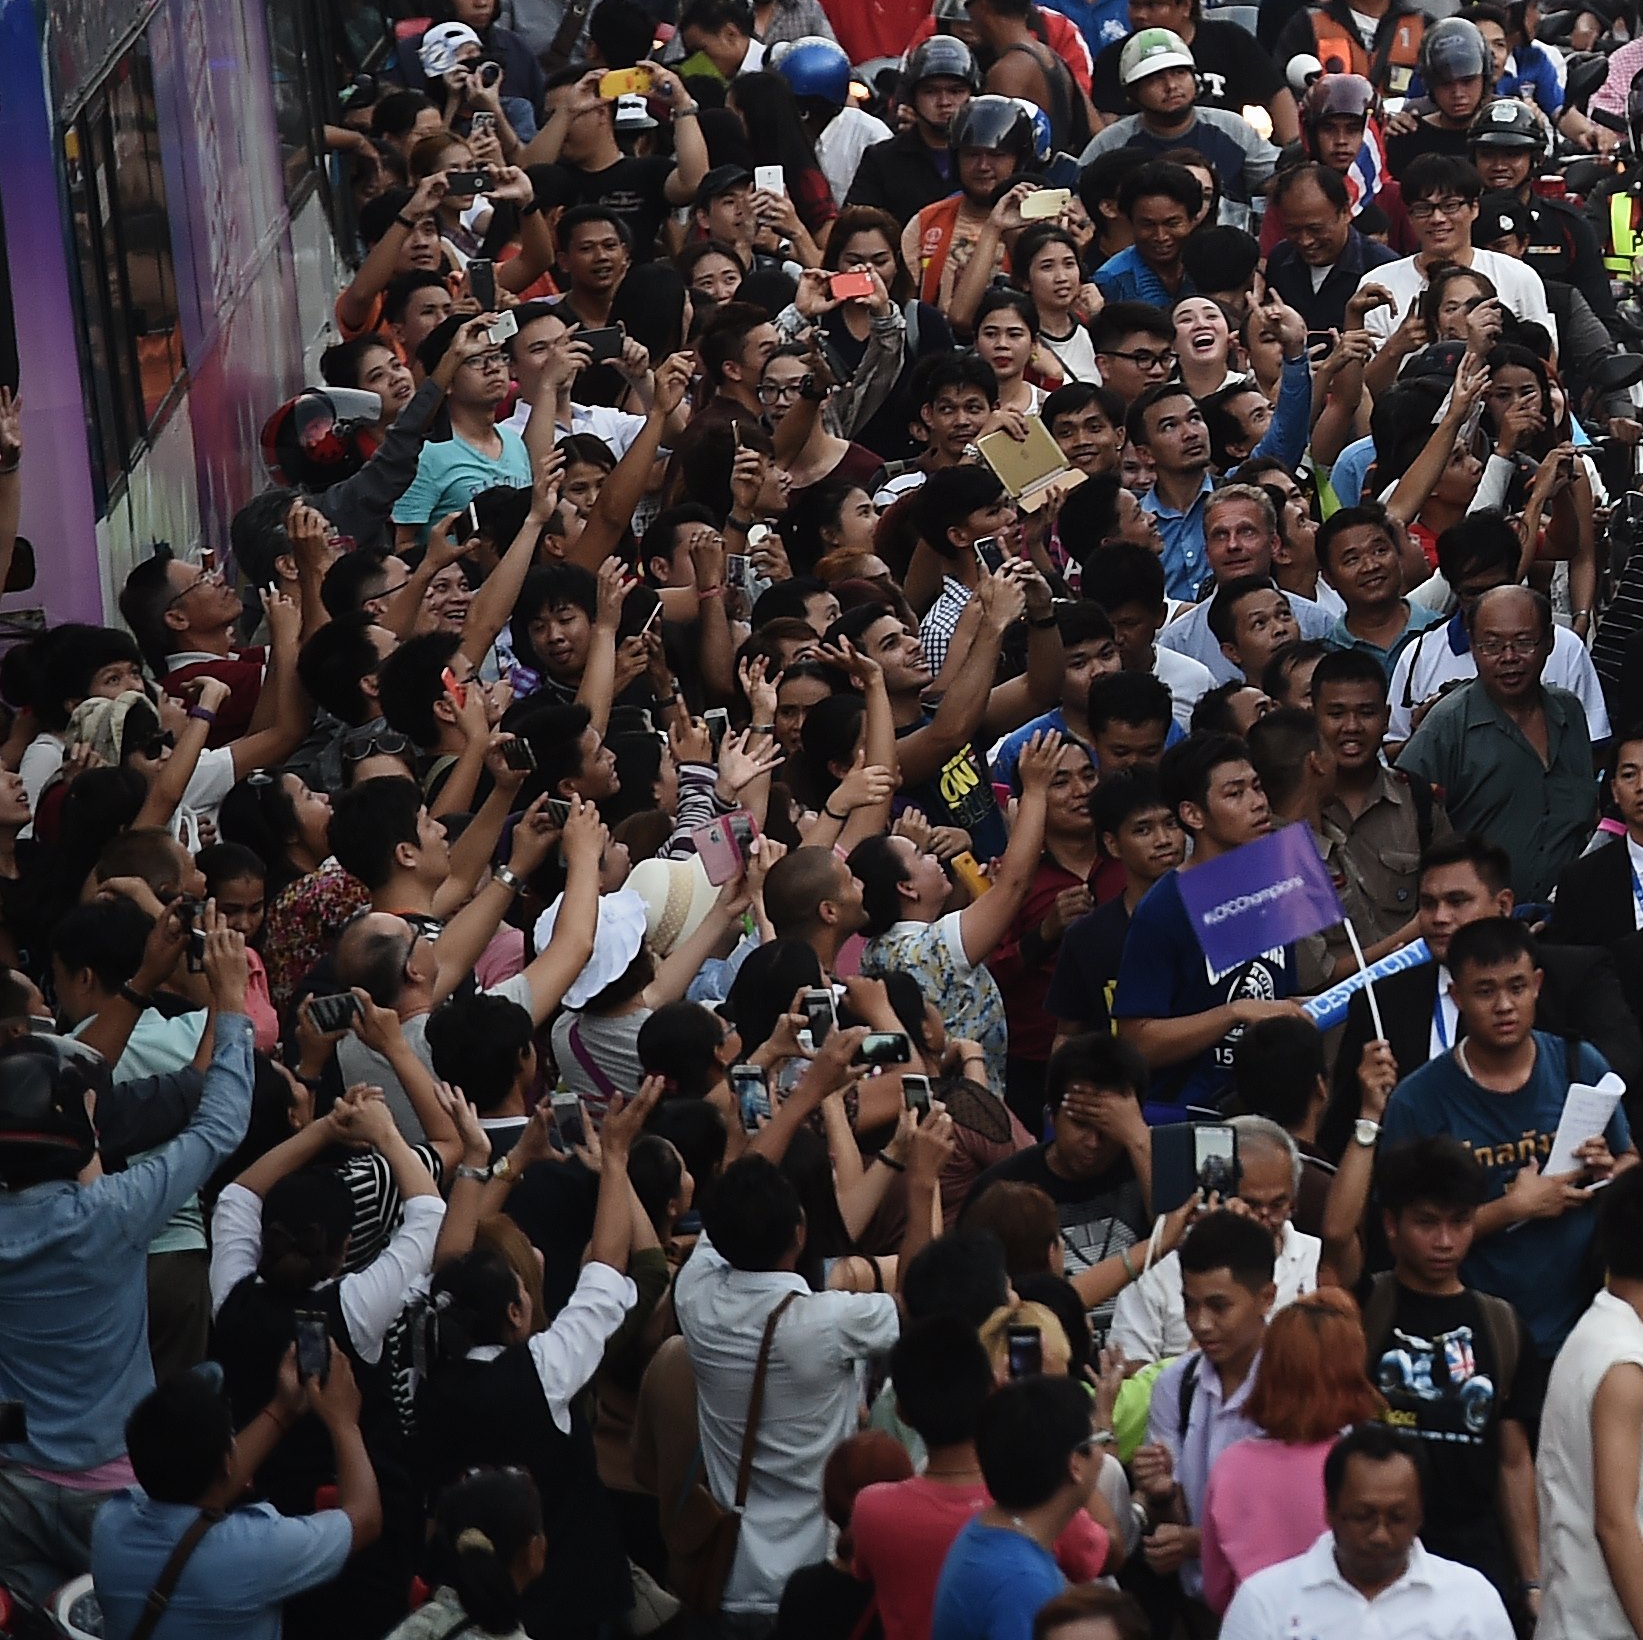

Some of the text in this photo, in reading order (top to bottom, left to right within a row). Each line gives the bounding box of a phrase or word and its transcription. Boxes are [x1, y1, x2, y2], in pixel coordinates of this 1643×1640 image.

[1302, 941, 1425, 1020] ICESTER CITY
[1213, 1047, 1235, 1065] 15
